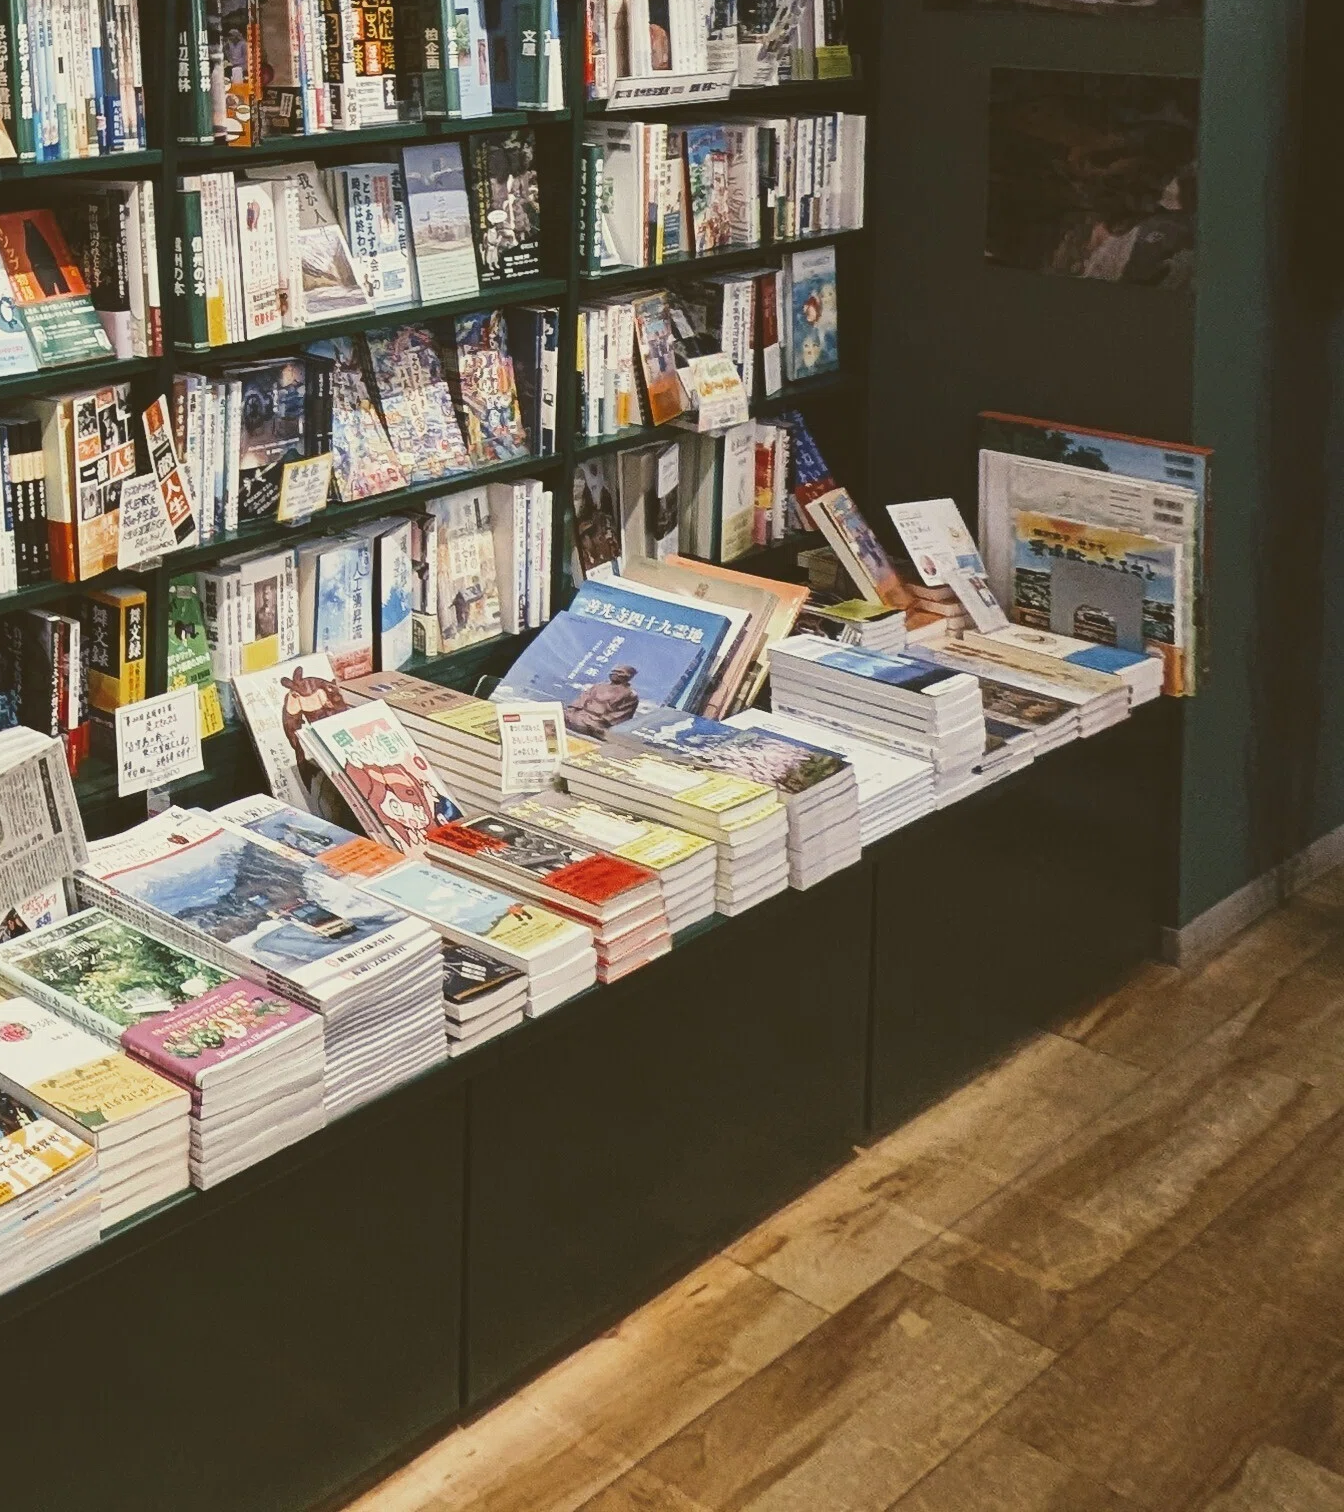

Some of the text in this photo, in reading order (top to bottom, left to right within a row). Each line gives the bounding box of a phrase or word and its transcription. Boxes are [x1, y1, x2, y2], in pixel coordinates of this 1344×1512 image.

[17, 23, 32, 120] ほおずき書籍
[425, 28, 440, 70] 柏企画
